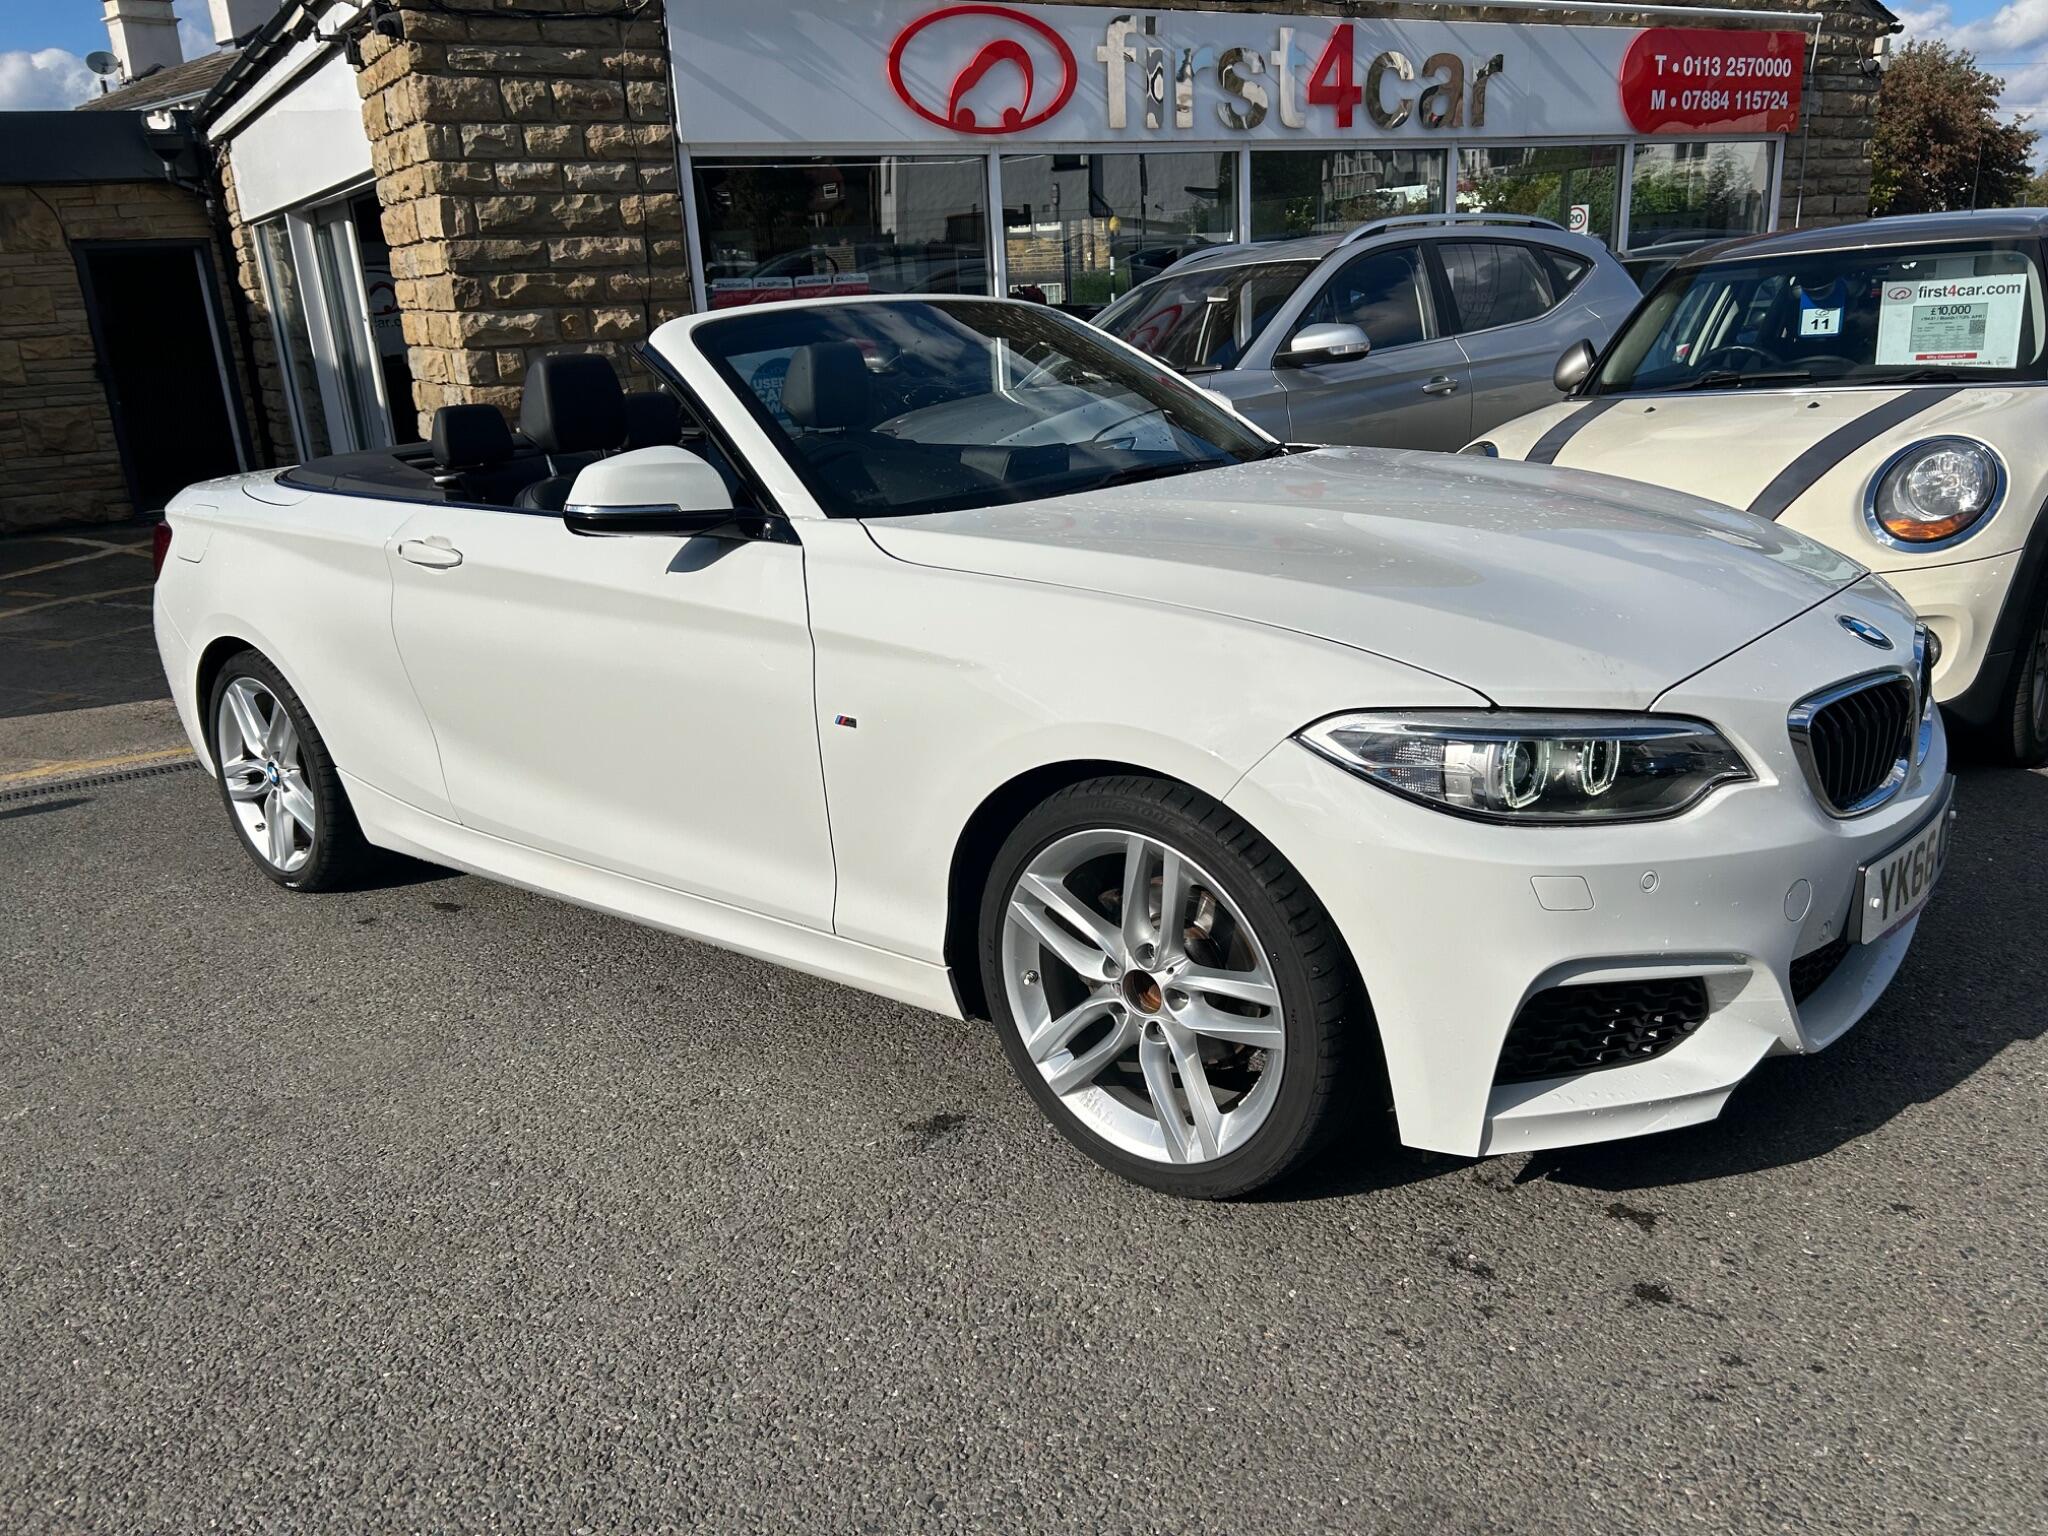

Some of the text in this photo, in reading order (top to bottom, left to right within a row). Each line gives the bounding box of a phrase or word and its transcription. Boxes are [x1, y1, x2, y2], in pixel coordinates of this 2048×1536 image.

[1097, 15, 1504, 130] first4car
[1654, 54, 1792, 78] T 0113 2570000
[1651, 89, 1789, 111] M 07884 115724
[1570, 213, 1583, 224] 20
[1918, 284, 2021, 299] first4car.com
[1930, 305, 1972, 316] £10,000
[1810, 318, 1829, 330] 11
[1880, 829, 1936, 921] YK66
